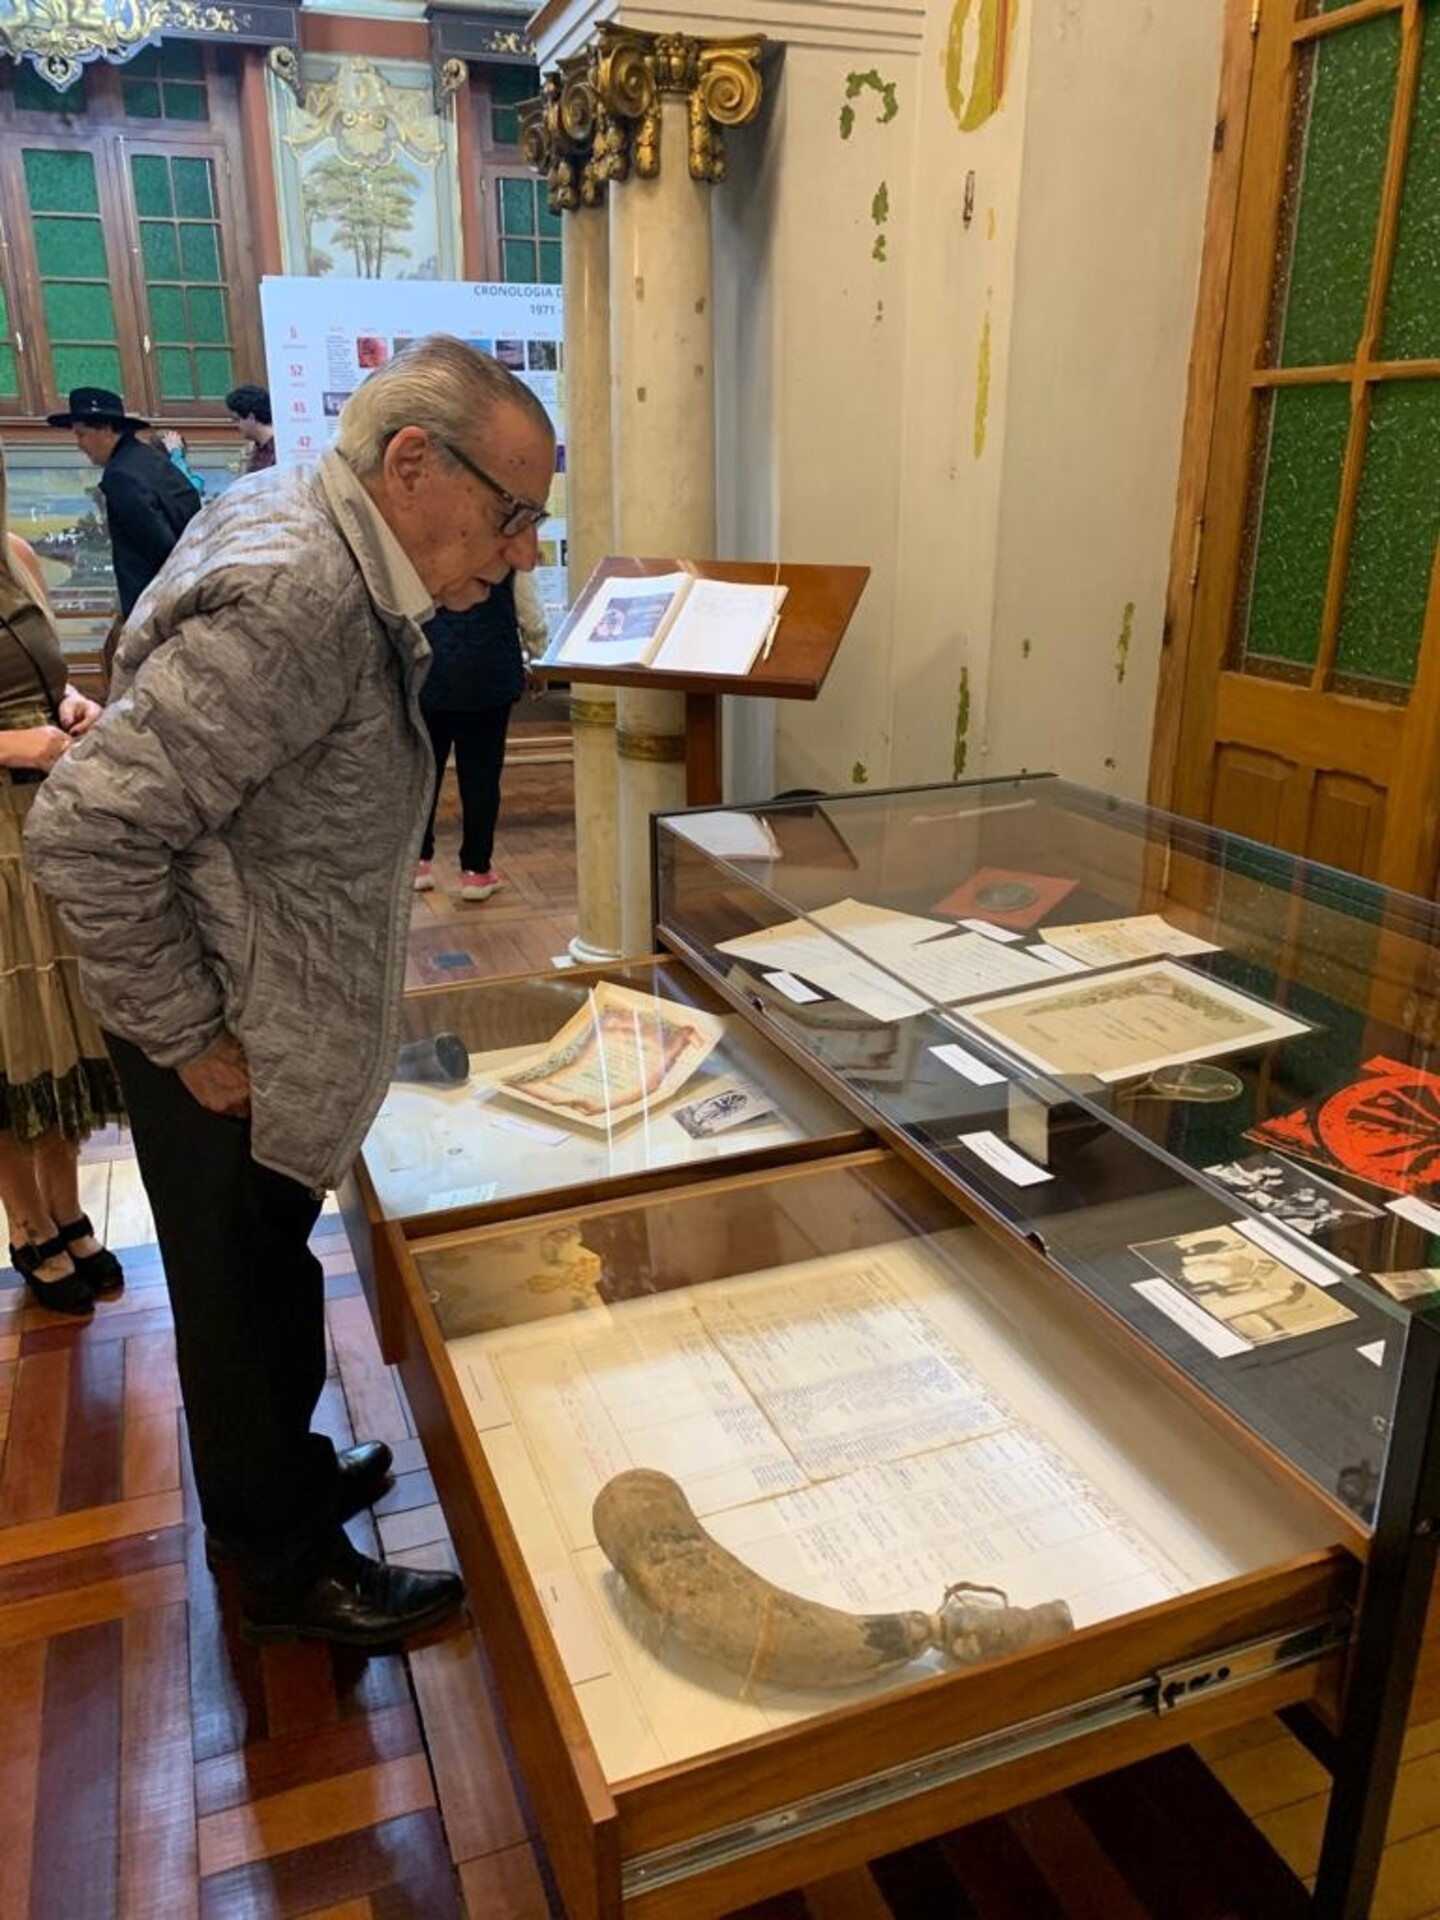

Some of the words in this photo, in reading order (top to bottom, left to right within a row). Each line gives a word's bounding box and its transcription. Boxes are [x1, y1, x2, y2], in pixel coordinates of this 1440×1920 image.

[474, 285, 553, 299] CRONOLOGIA
[530, 304, 555, 315] 1971
[290, 364, 303, 376] 52
